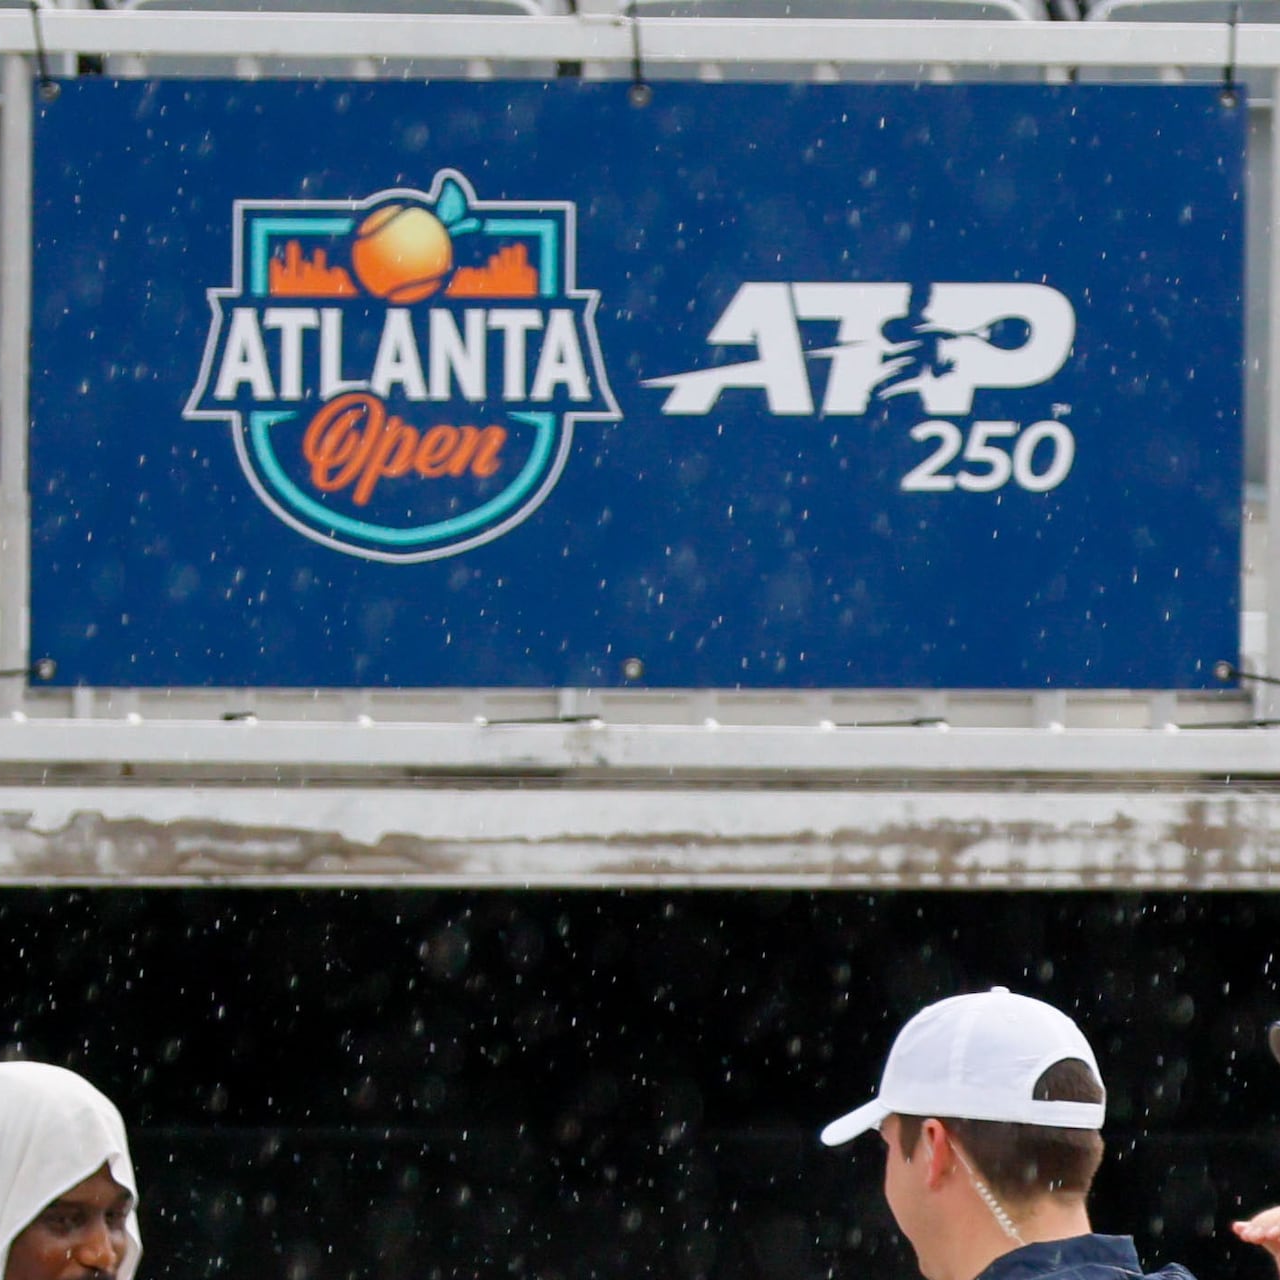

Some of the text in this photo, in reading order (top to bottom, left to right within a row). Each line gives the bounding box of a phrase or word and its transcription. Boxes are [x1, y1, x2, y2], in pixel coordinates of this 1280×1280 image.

[214, 306, 592, 402] ATLANTA
[640, 281, 1077, 416] ATP
[303, 393, 506, 505] Open
[900, 419, 1076, 493] 250
